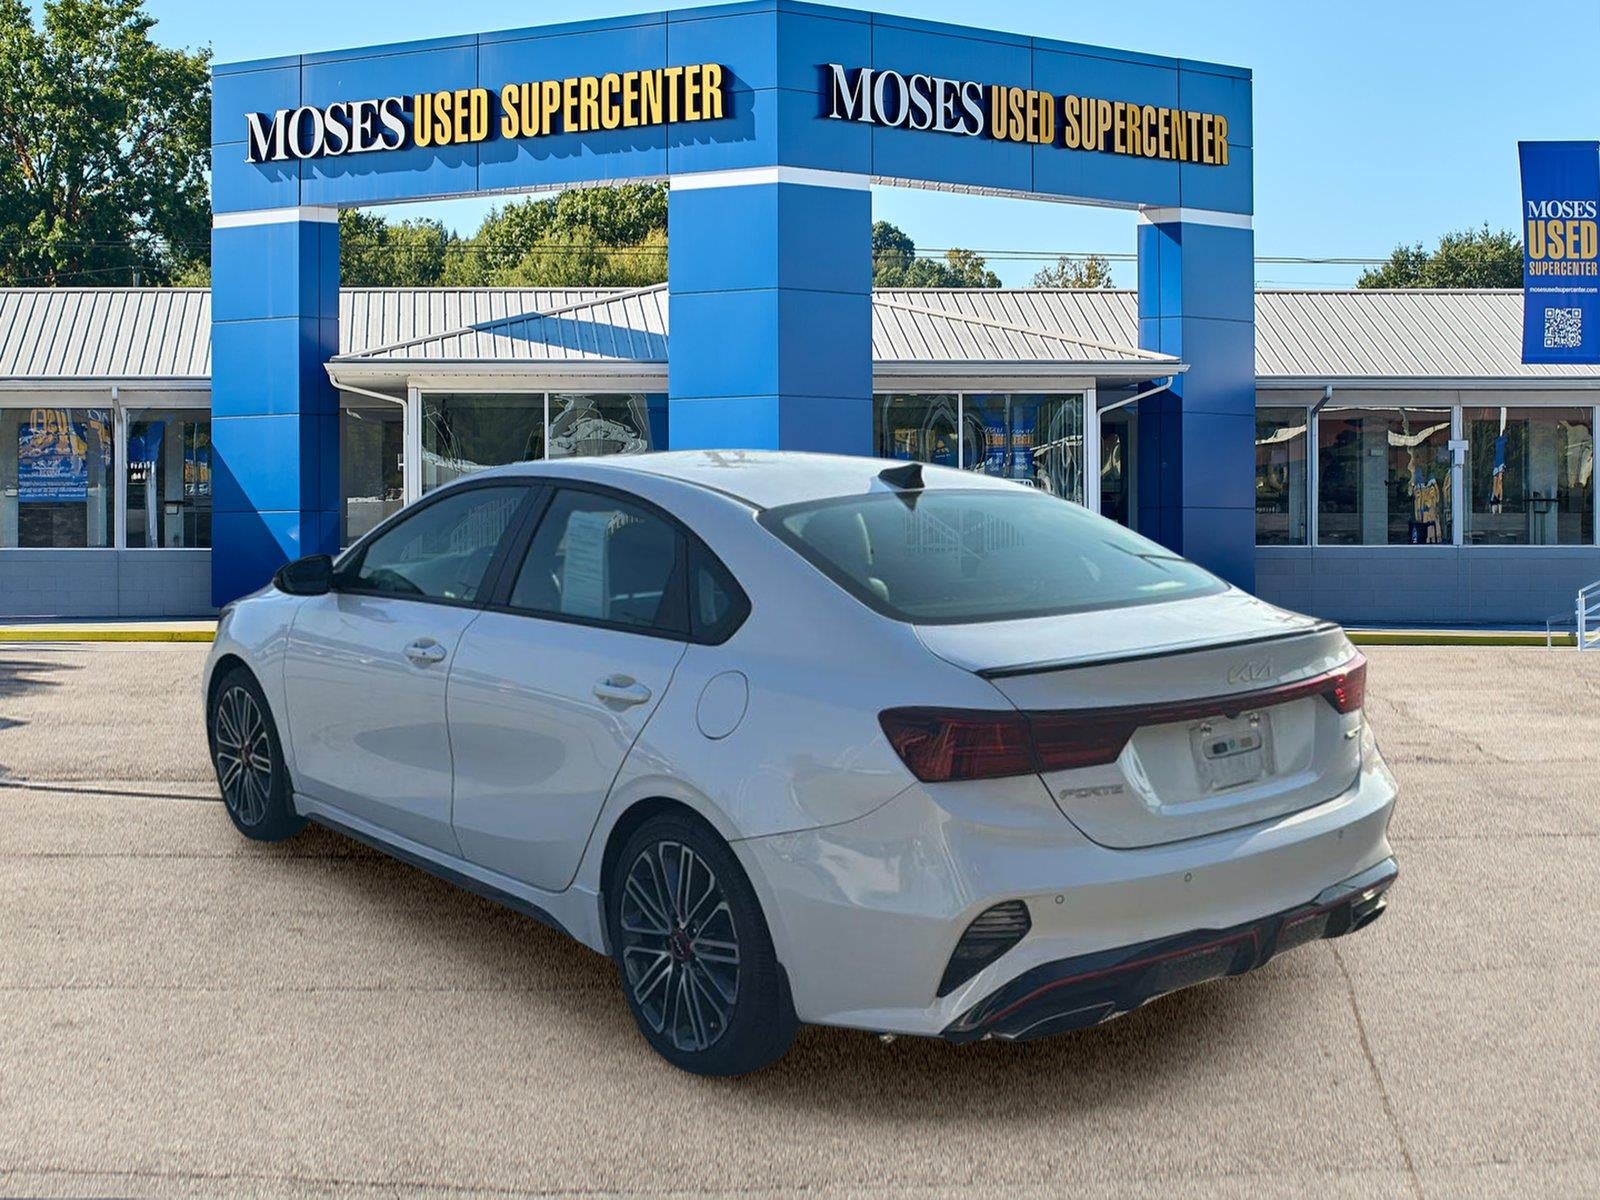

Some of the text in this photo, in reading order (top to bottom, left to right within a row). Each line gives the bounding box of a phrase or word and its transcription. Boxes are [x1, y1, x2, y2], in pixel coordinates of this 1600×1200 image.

[244, 63, 724, 164] MOSES USED SUPERCENTER
[828, 63, 1229, 166] MOSES USED SUPERCENTER
[1527, 200, 1597, 218] MOSES
[1527, 219, 1598, 260] USED
[1529, 261, 1598, 276] SUPERCENTER
